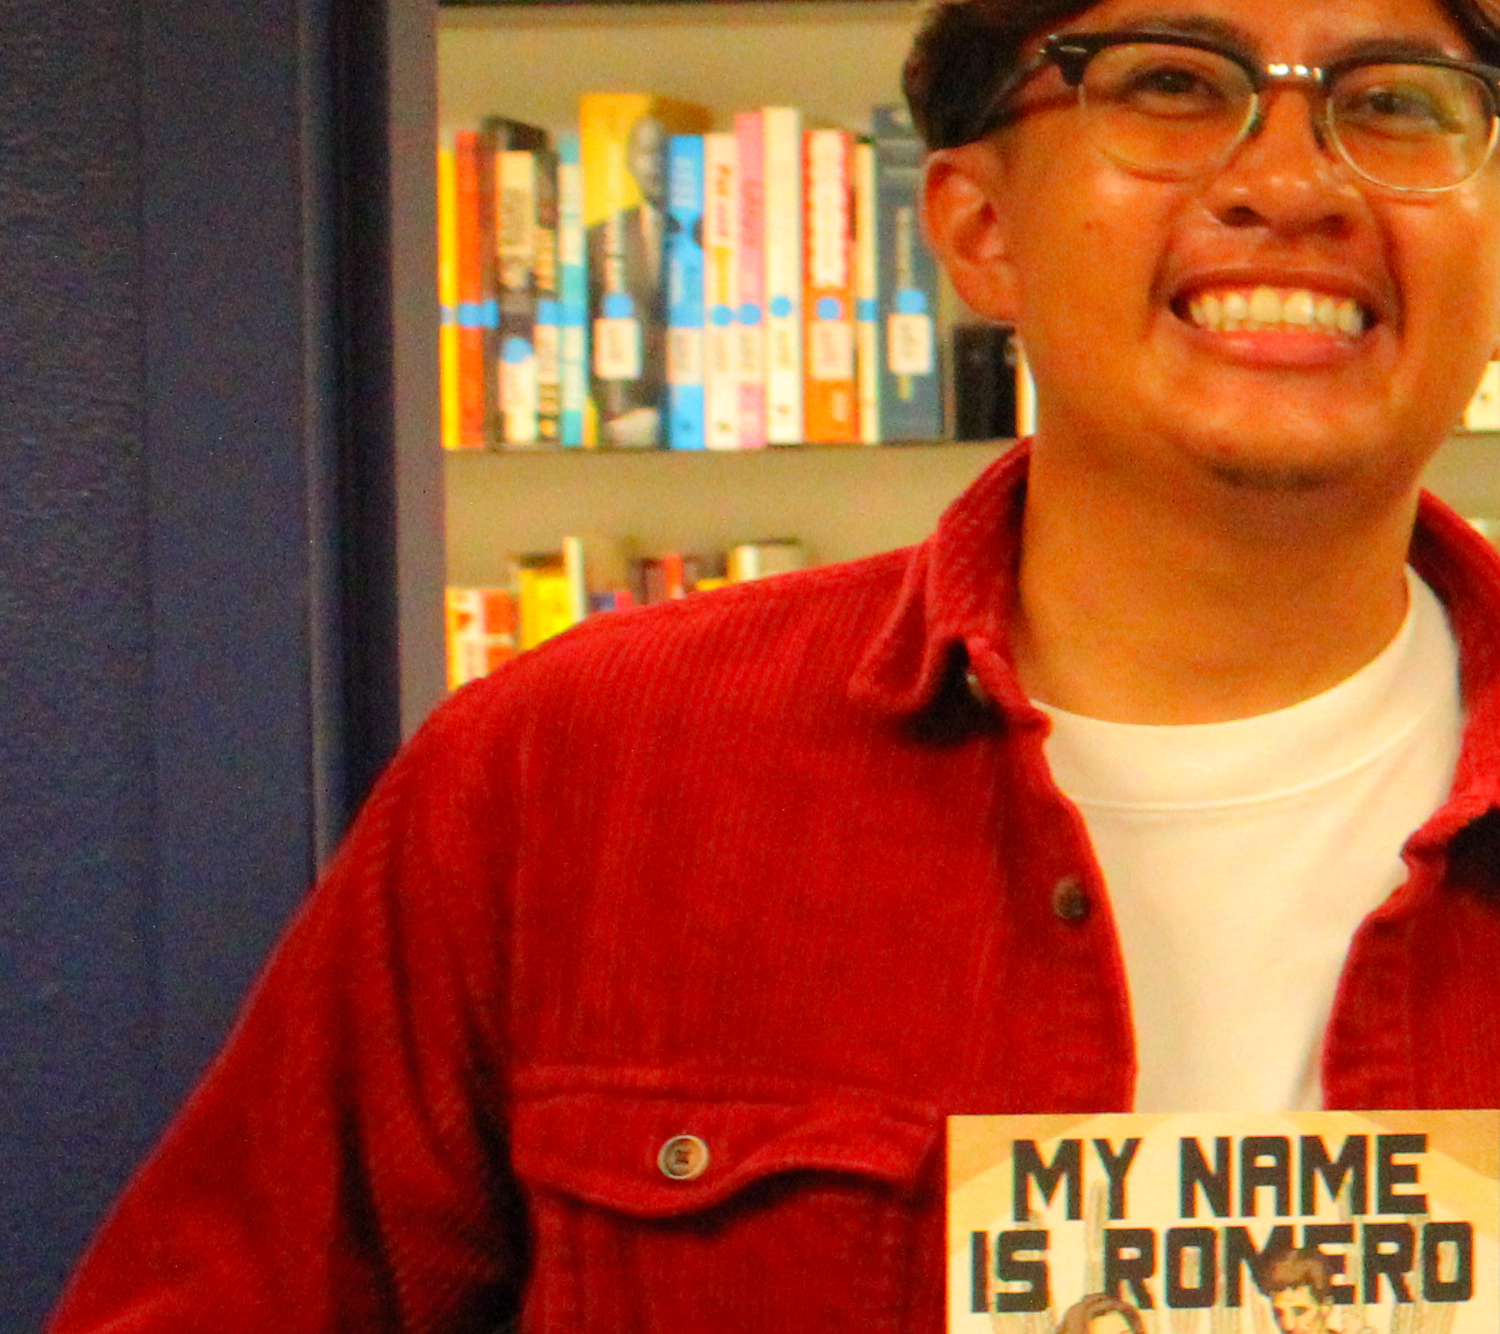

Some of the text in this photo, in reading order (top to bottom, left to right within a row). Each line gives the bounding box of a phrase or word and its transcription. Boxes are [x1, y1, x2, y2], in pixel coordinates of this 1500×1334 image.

[1012, 1134, 1427, 1222] MY NAME
[972, 1220, 1473, 1313] IS ROMERO
